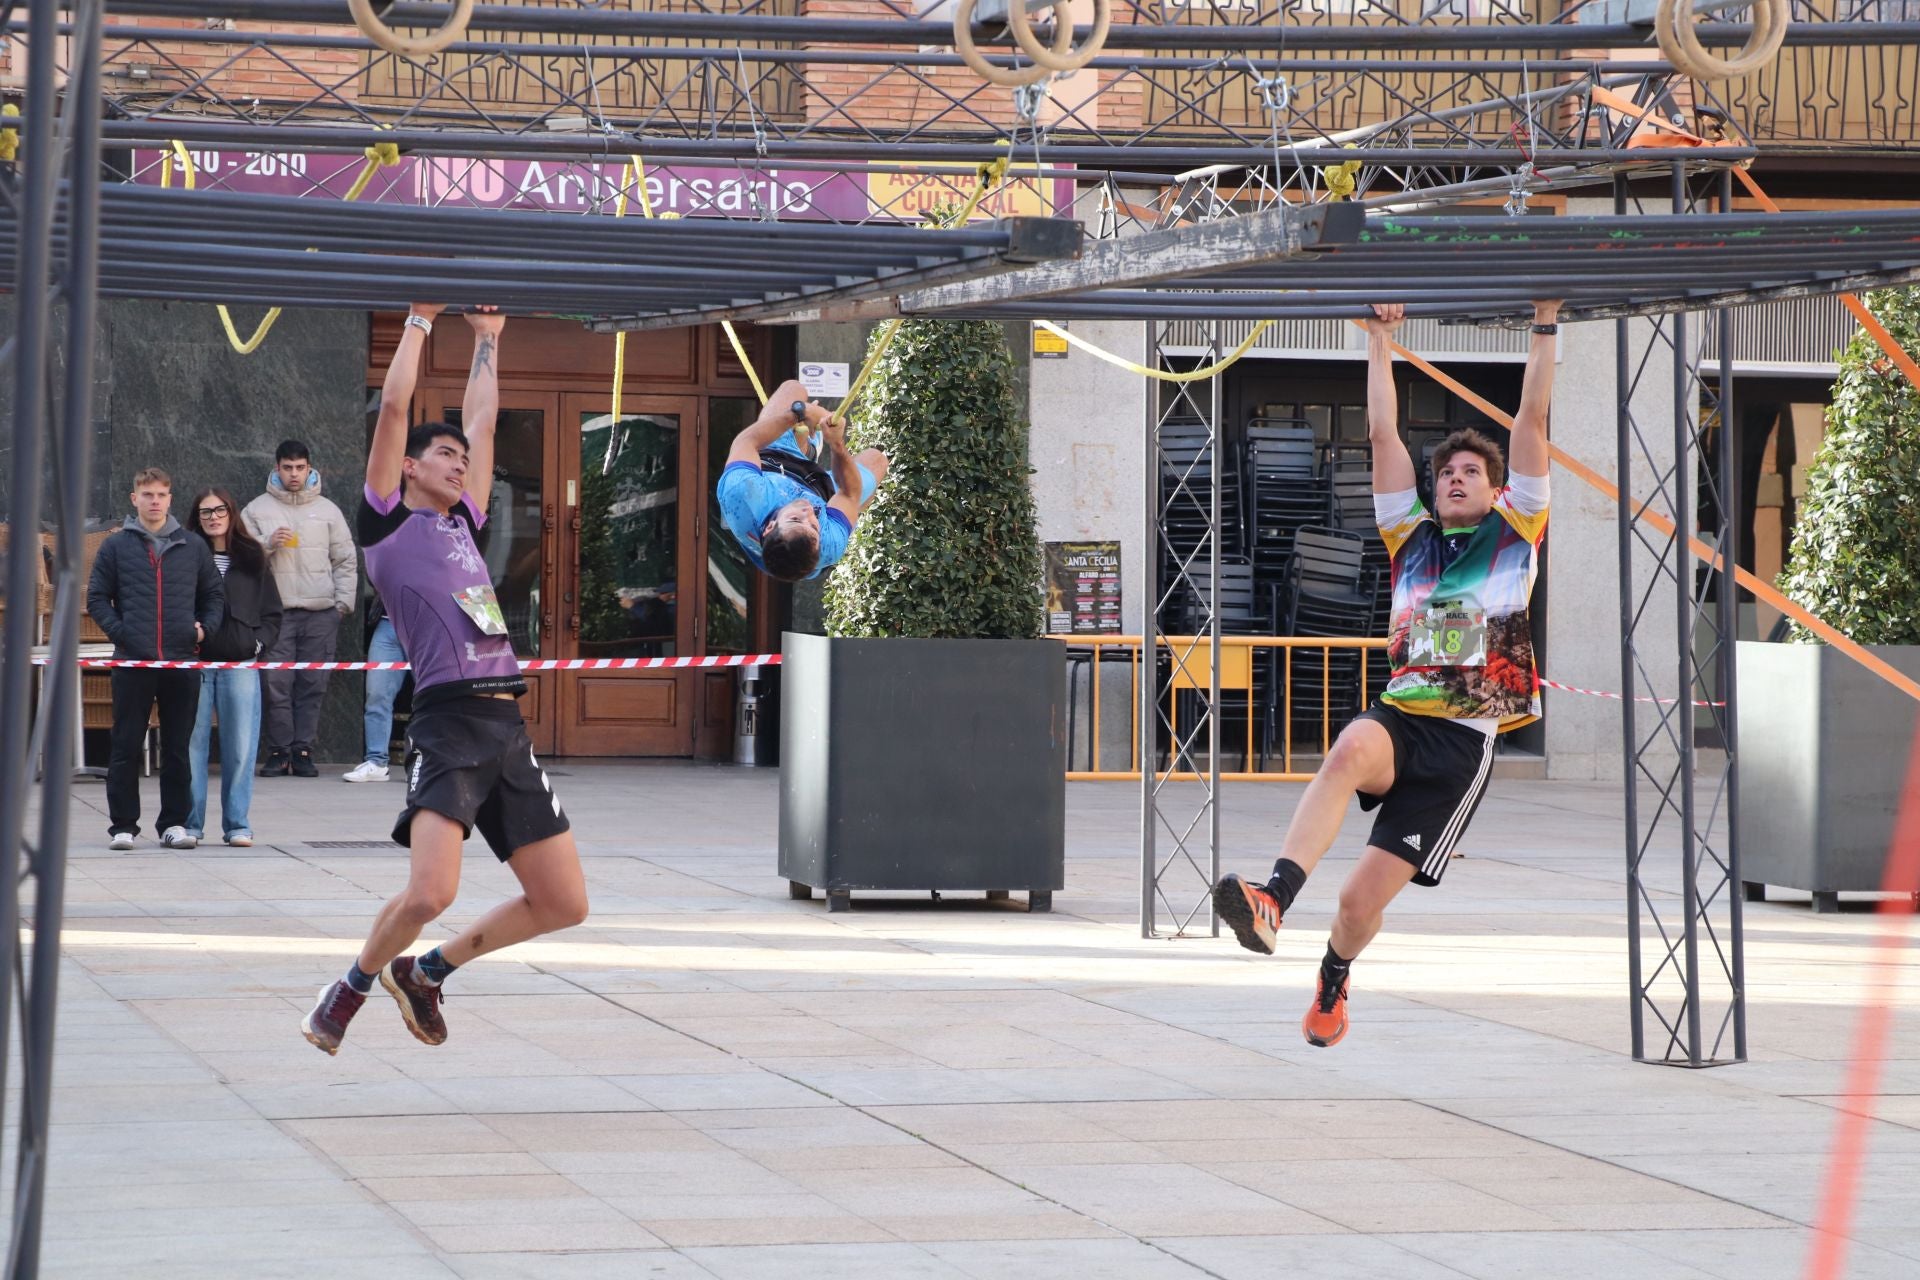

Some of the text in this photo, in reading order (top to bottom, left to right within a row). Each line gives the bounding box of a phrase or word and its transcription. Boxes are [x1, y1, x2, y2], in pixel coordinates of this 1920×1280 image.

[159, 150, 219, 173] 910
[245, 152, 307, 178] 2010
[514, 161, 812, 212] Aniversario
[889, 172, 1033, 190] ASOIAN
[1063, 556, 1118, 566] SANTA CECILIA
[1446, 612, 1468, 620] RACE
[1431, 629, 1462, 655] 18
[1402, 836, 1422, 852] adidas
